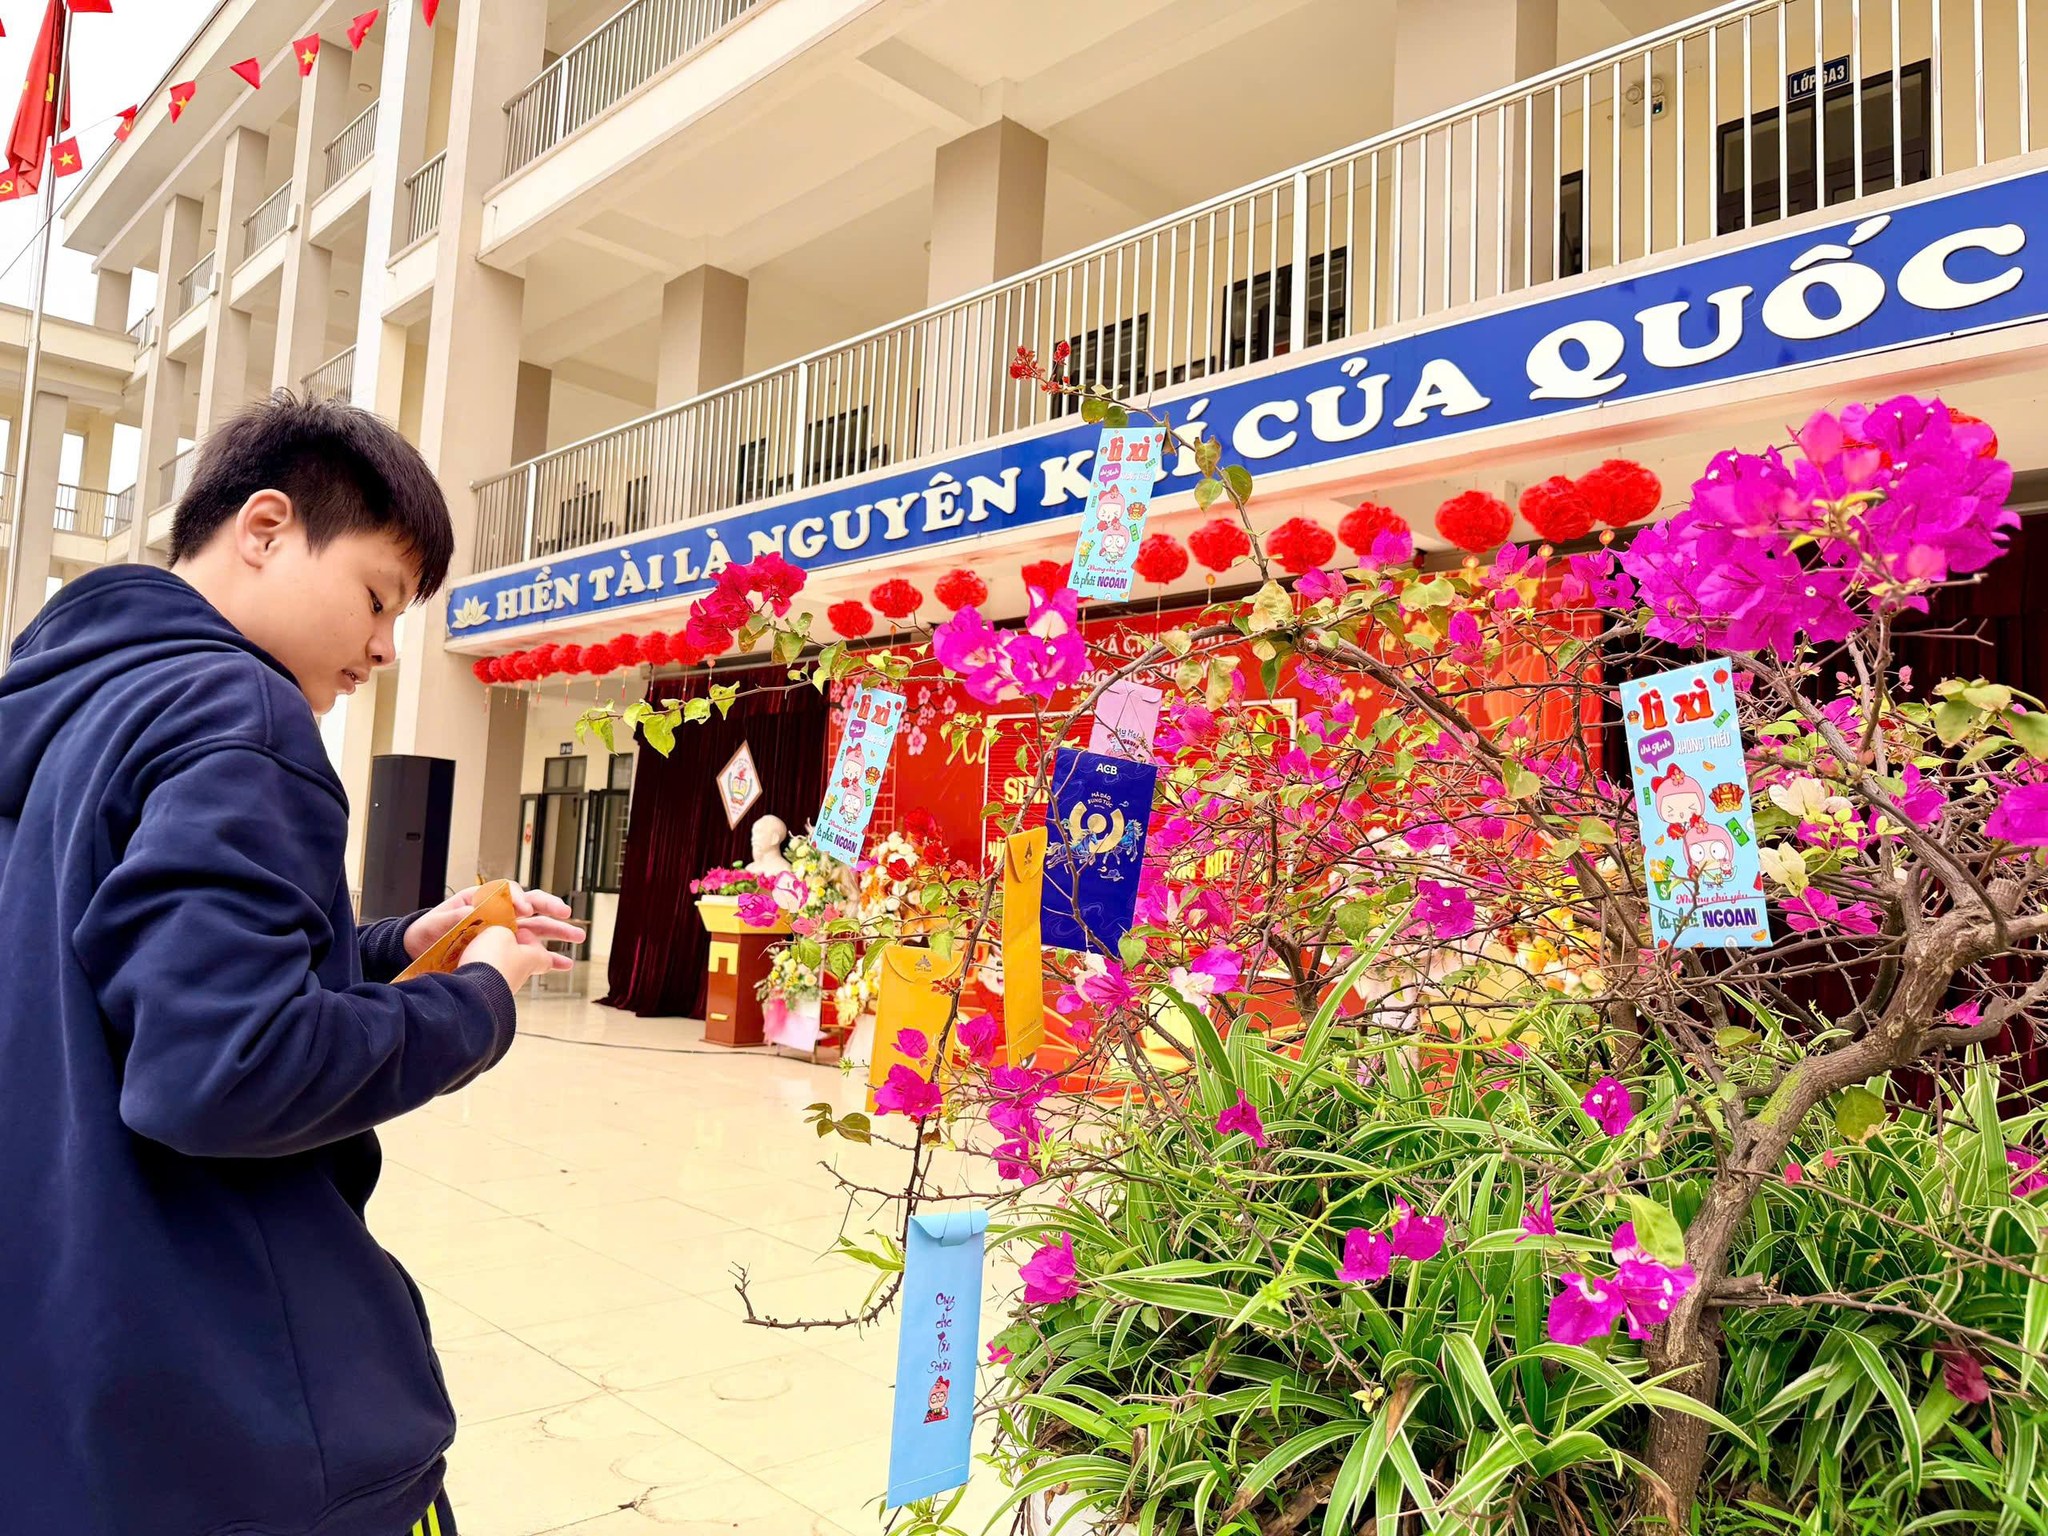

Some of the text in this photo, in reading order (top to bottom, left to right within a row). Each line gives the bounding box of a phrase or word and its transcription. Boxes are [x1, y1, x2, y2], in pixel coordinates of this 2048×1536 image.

[496, 215, 2027, 622] HIỀN TÀI LÀ NGUYÊN KÍ CỦA QUỐC
[1097, 576, 1128, 589] NGOAN
[1638, 678, 1714, 731] lì xì
[1096, 763, 1118, 775] ACB
[834, 833, 858, 854] NGOAN
[1702, 907, 1757, 928] NGOAN
